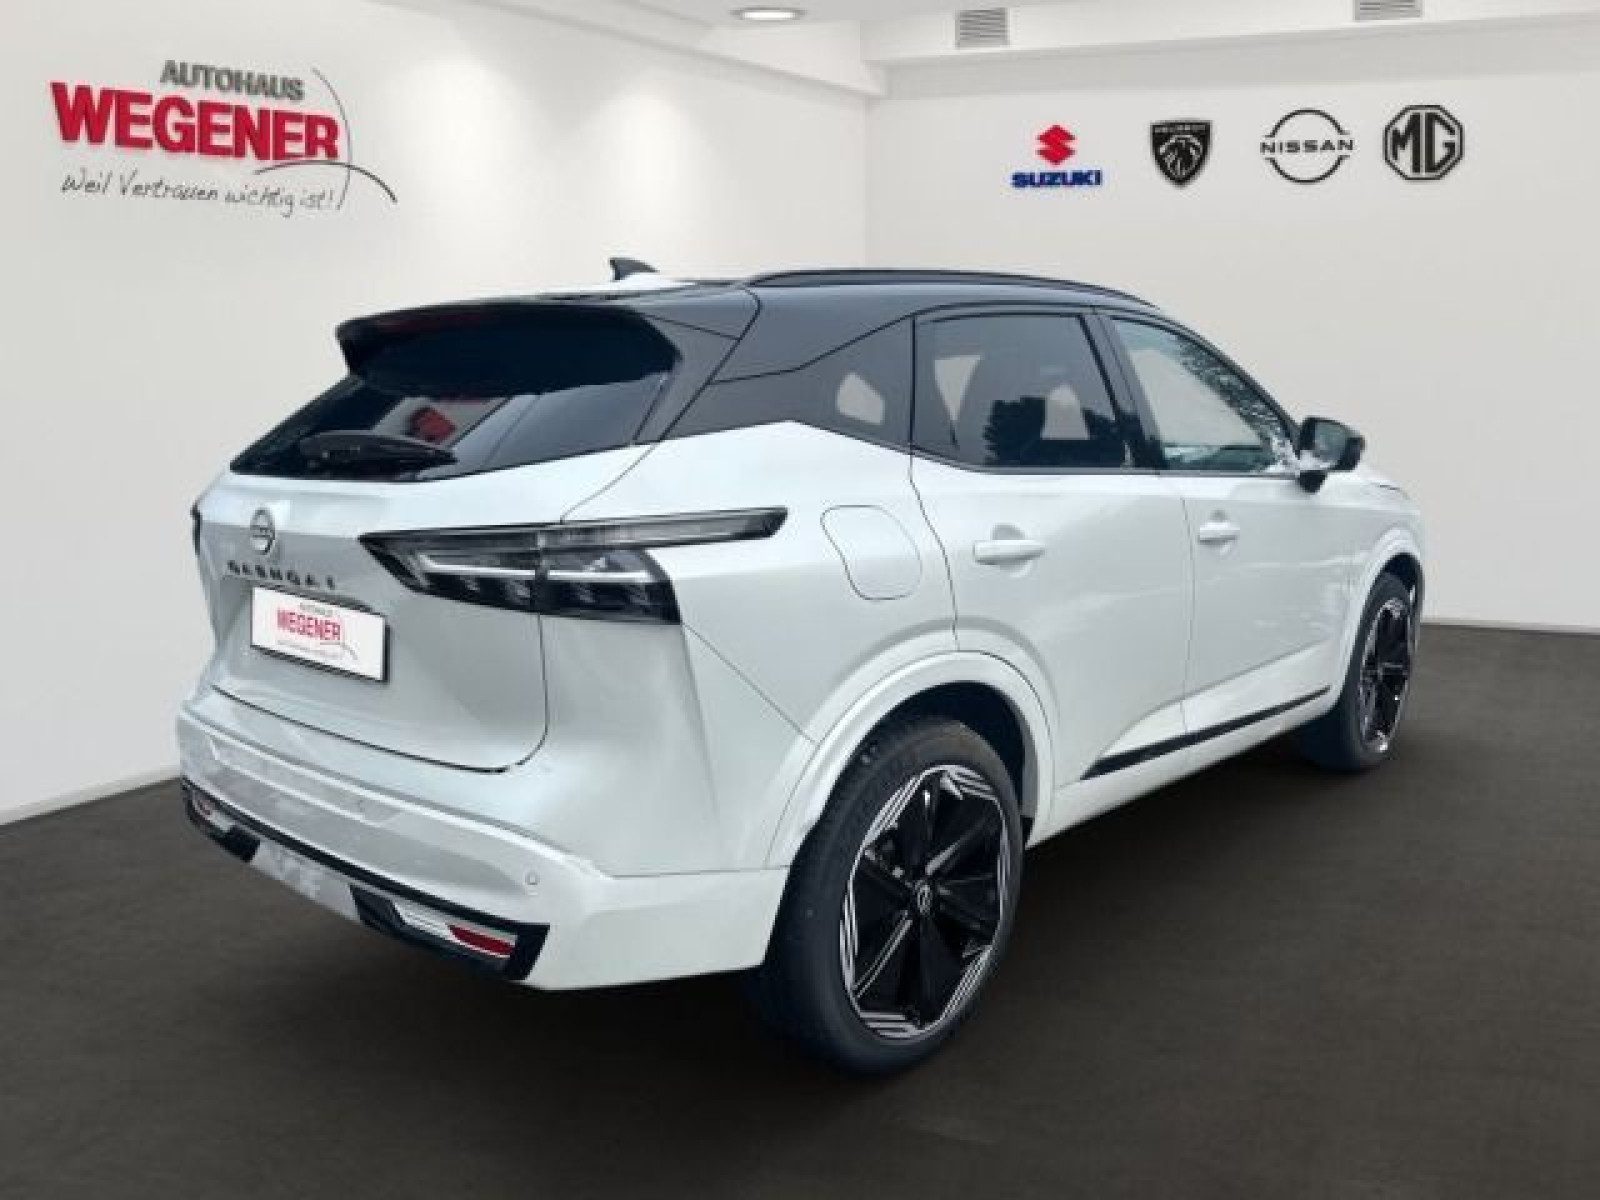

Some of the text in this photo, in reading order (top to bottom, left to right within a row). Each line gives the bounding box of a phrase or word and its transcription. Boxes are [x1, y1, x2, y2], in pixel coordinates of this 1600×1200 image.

[160, 60, 304, 101] AUTOHAUS
[50, 81, 339, 161] WEGENER
[1260, 139, 1353, 154] NISSAN
[1391, 112, 1456, 174] MG
[61, 167, 113, 195] Weil
[119, 169, 218, 201] Vertrauen
[224, 184, 295, 219] wichtig
[1011, 169, 1102, 188] SUZUKI
[277, 608, 341, 641] WEGENER
